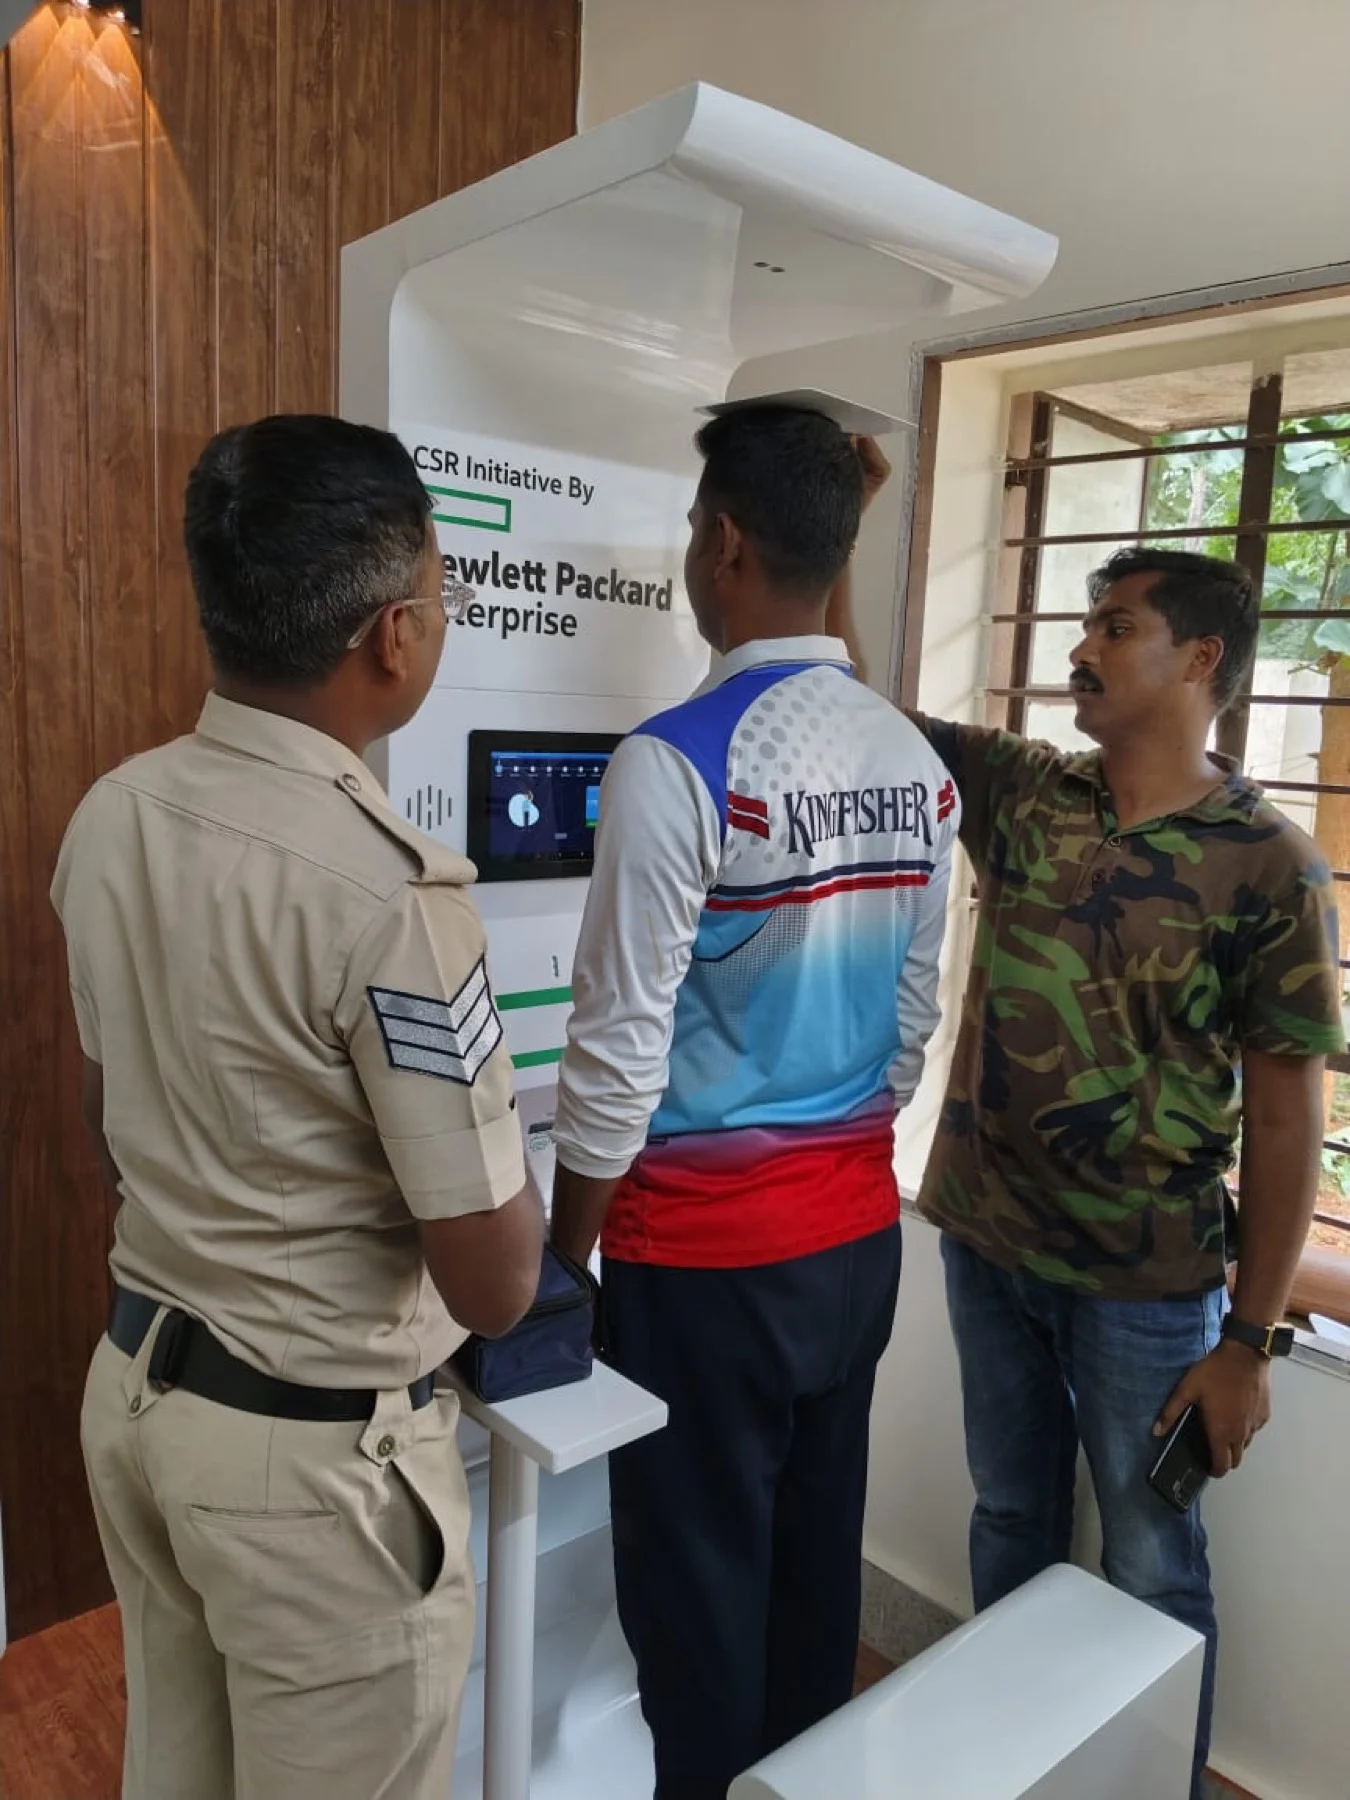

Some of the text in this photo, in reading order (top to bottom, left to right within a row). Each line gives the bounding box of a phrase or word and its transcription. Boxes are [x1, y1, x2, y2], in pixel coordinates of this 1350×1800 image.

[413, 446, 595, 506] CSR Initiative By
[441, 550, 673, 612] ewlett Packard
